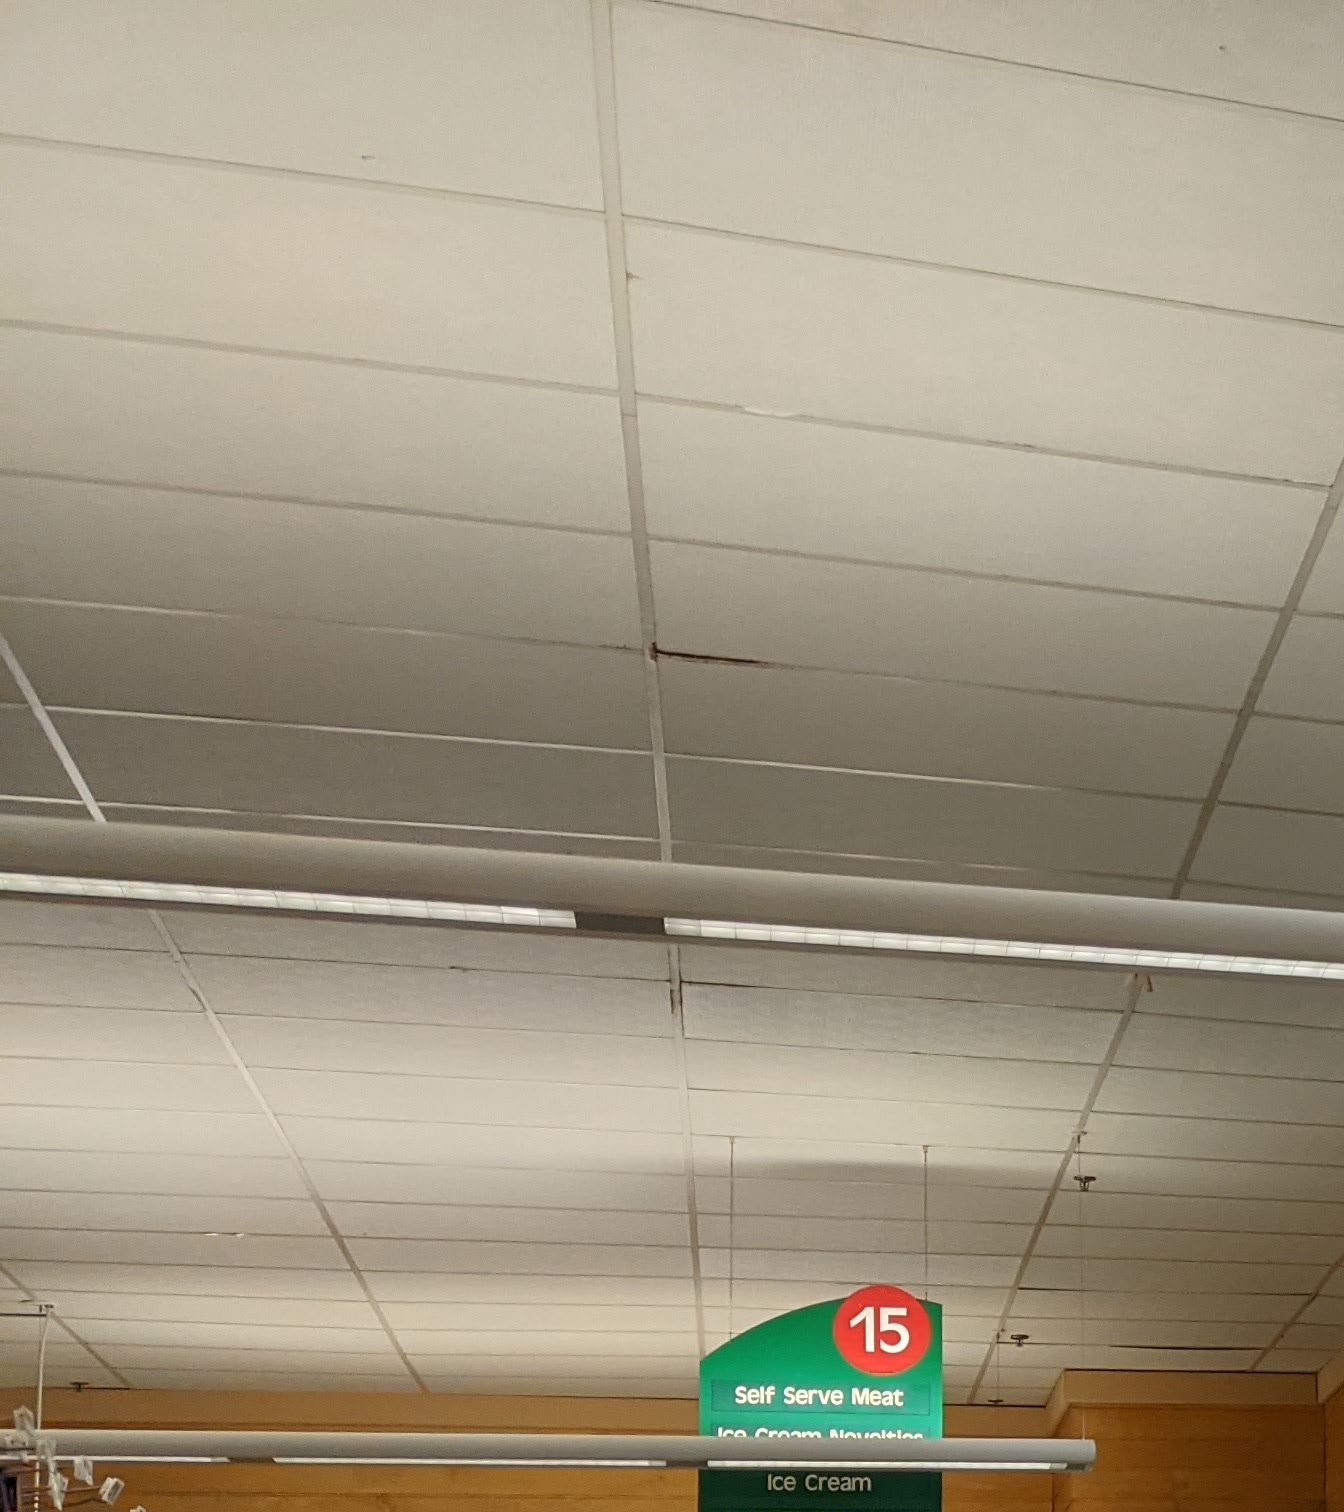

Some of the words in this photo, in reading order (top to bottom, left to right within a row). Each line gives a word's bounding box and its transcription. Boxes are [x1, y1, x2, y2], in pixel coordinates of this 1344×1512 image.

[850, 1307, 910, 1353] 15
[735, 1386, 775, 1404] Self
[783, 1387, 843, 1405] Serve
[851, 1388, 904, 1406] Meat
[768, 1474, 796, 1491] Ice
[805, 1474, 871, 1491] Cream
